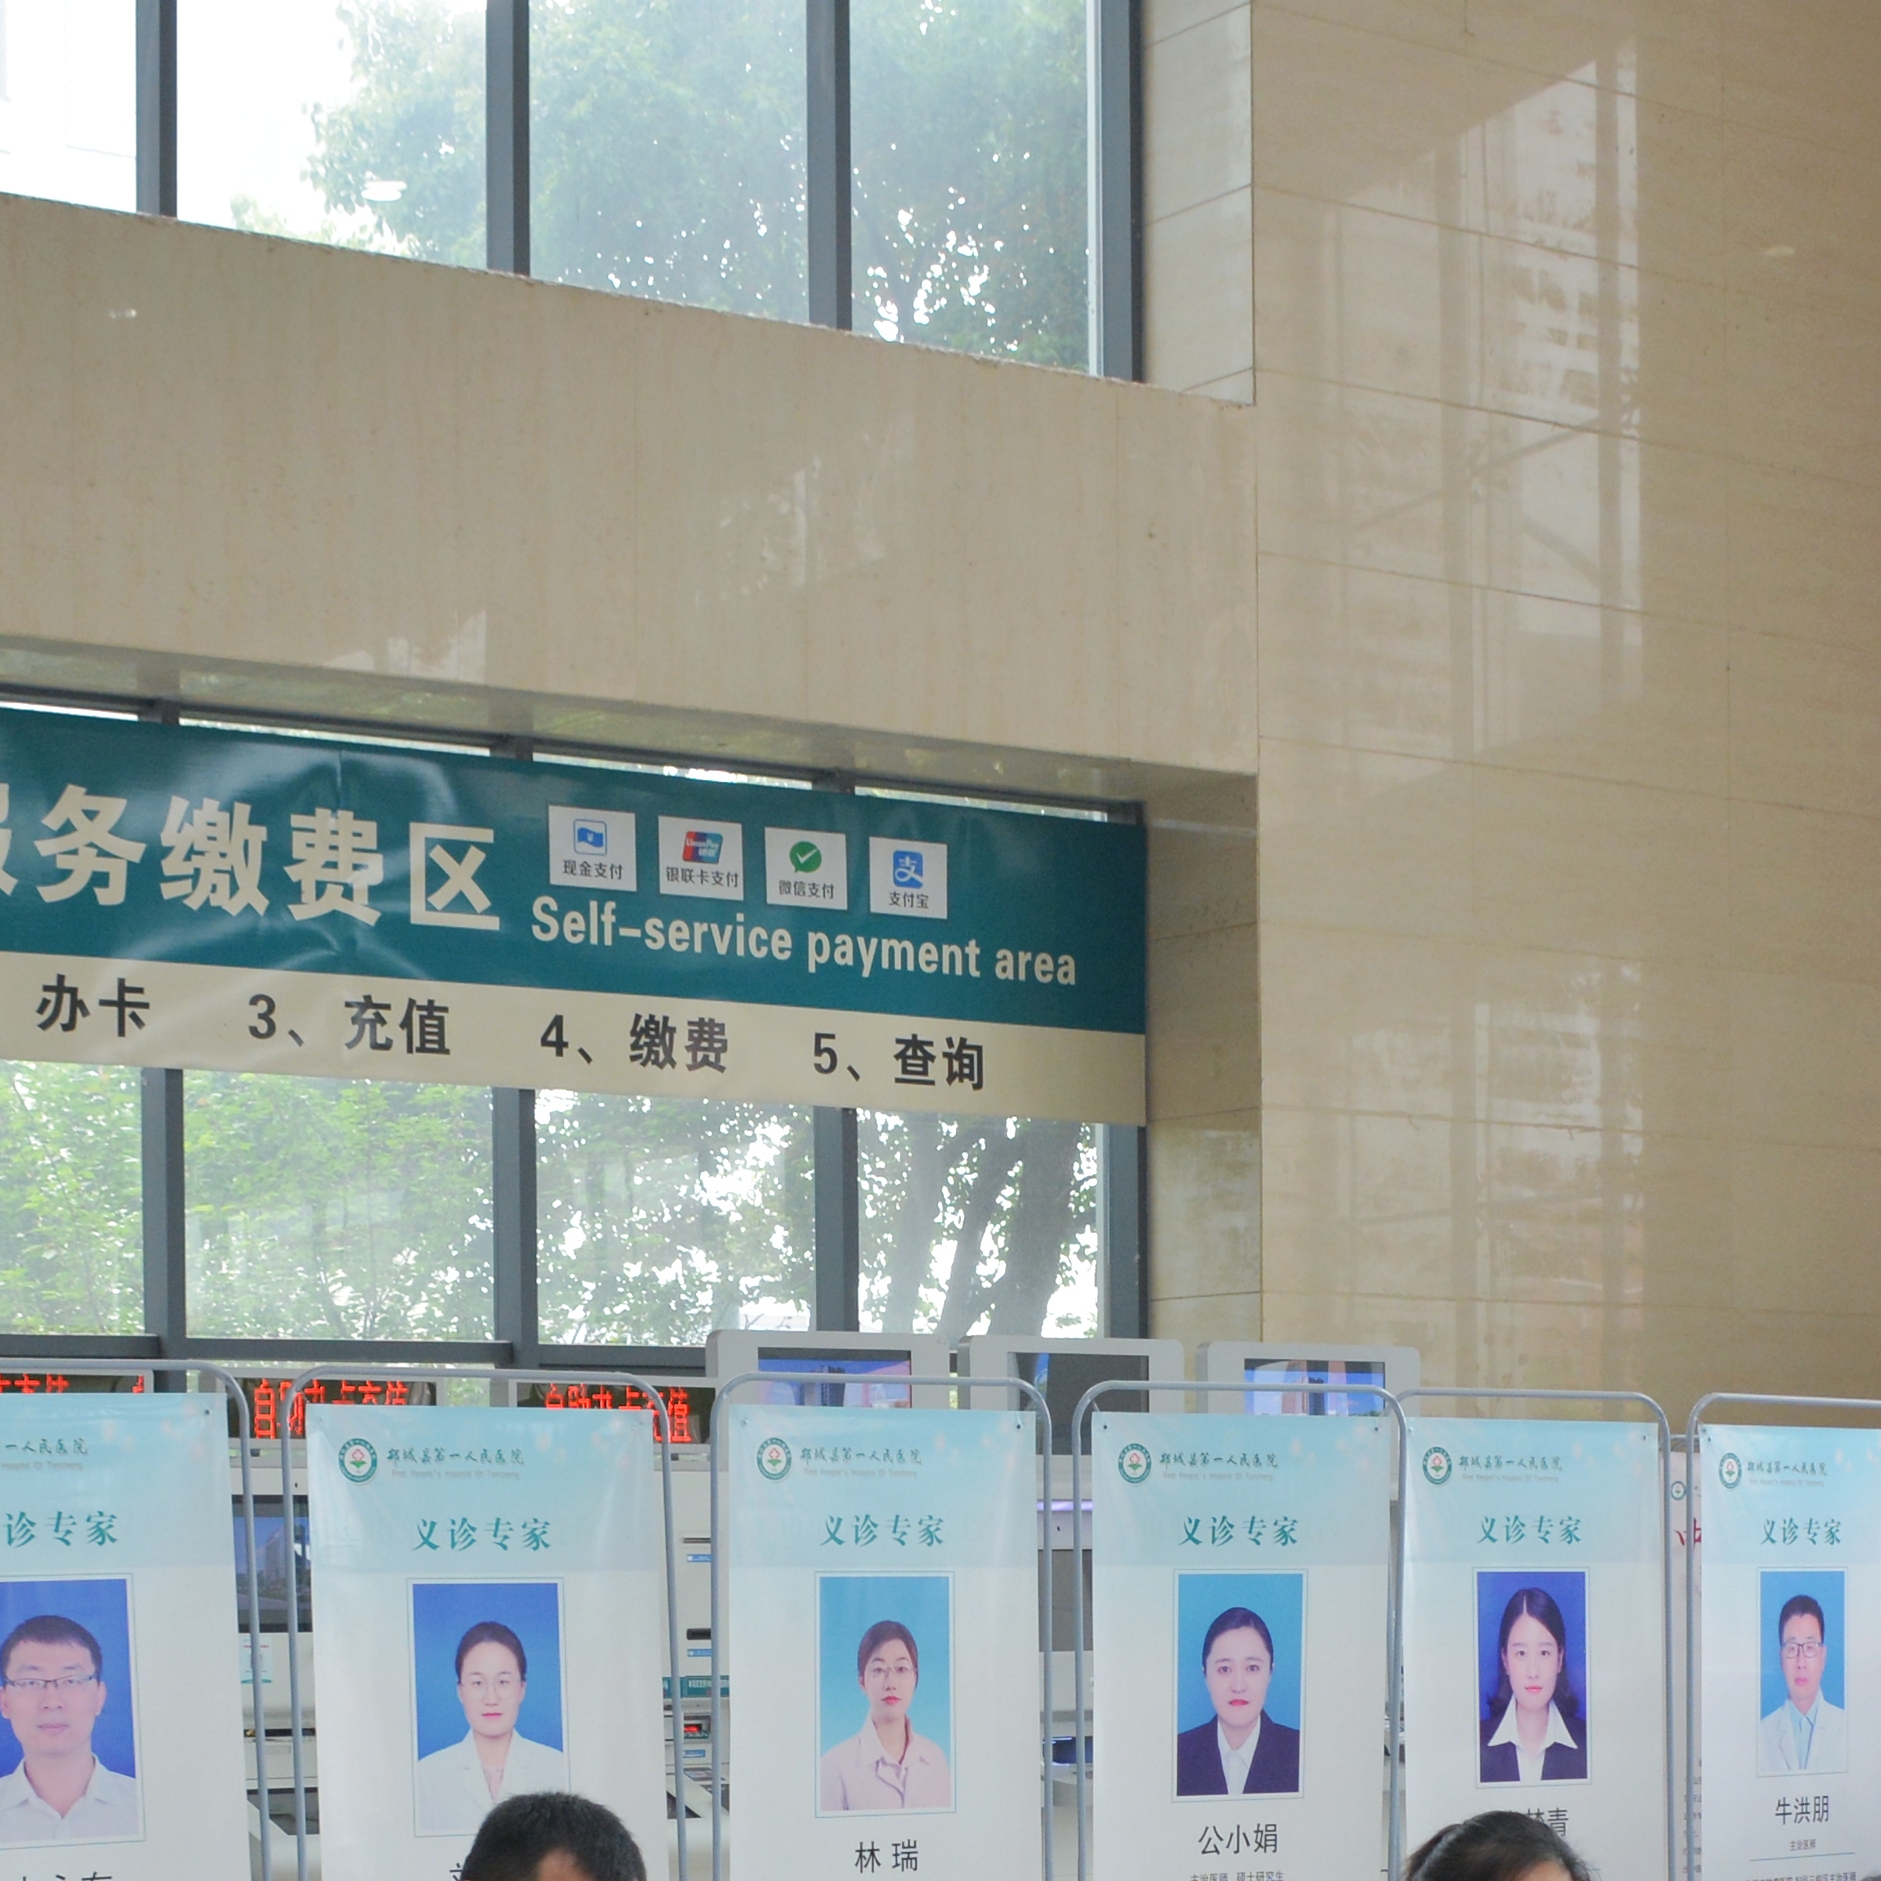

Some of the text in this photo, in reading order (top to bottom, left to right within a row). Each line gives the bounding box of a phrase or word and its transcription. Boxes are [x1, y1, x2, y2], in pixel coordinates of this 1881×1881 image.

[562, 859, 623, 880] 现金支付
[665, 866, 739, 888] 银联卡支付
[778, 879, 835, 899] 微信支付
[889, 891, 929, 909] 支付宝
[531, 896, 1077, 986] Self-service payment area
[246, 993, 451, 1057] 3、充值
[540, 1012, 729, 1074] 4、缴费
[813, 1032, 985, 1091] 5、查询
[412, 1516, 552, 1552] 义诊专家
[820, 1514, 945, 1547] 义诊专家
[1177, 1514, 1299, 1547] 义诊专家
[1477, 1514, 1582, 1545] 义诊专家
[1760, 1517, 1842, 1546] 义诊专家
[1775, 1796, 1829, 1825] 牛洪朋
[1198, 1822, 1279, 1855] 公小娟
[854, 1838, 919, 1874] 林瑞
